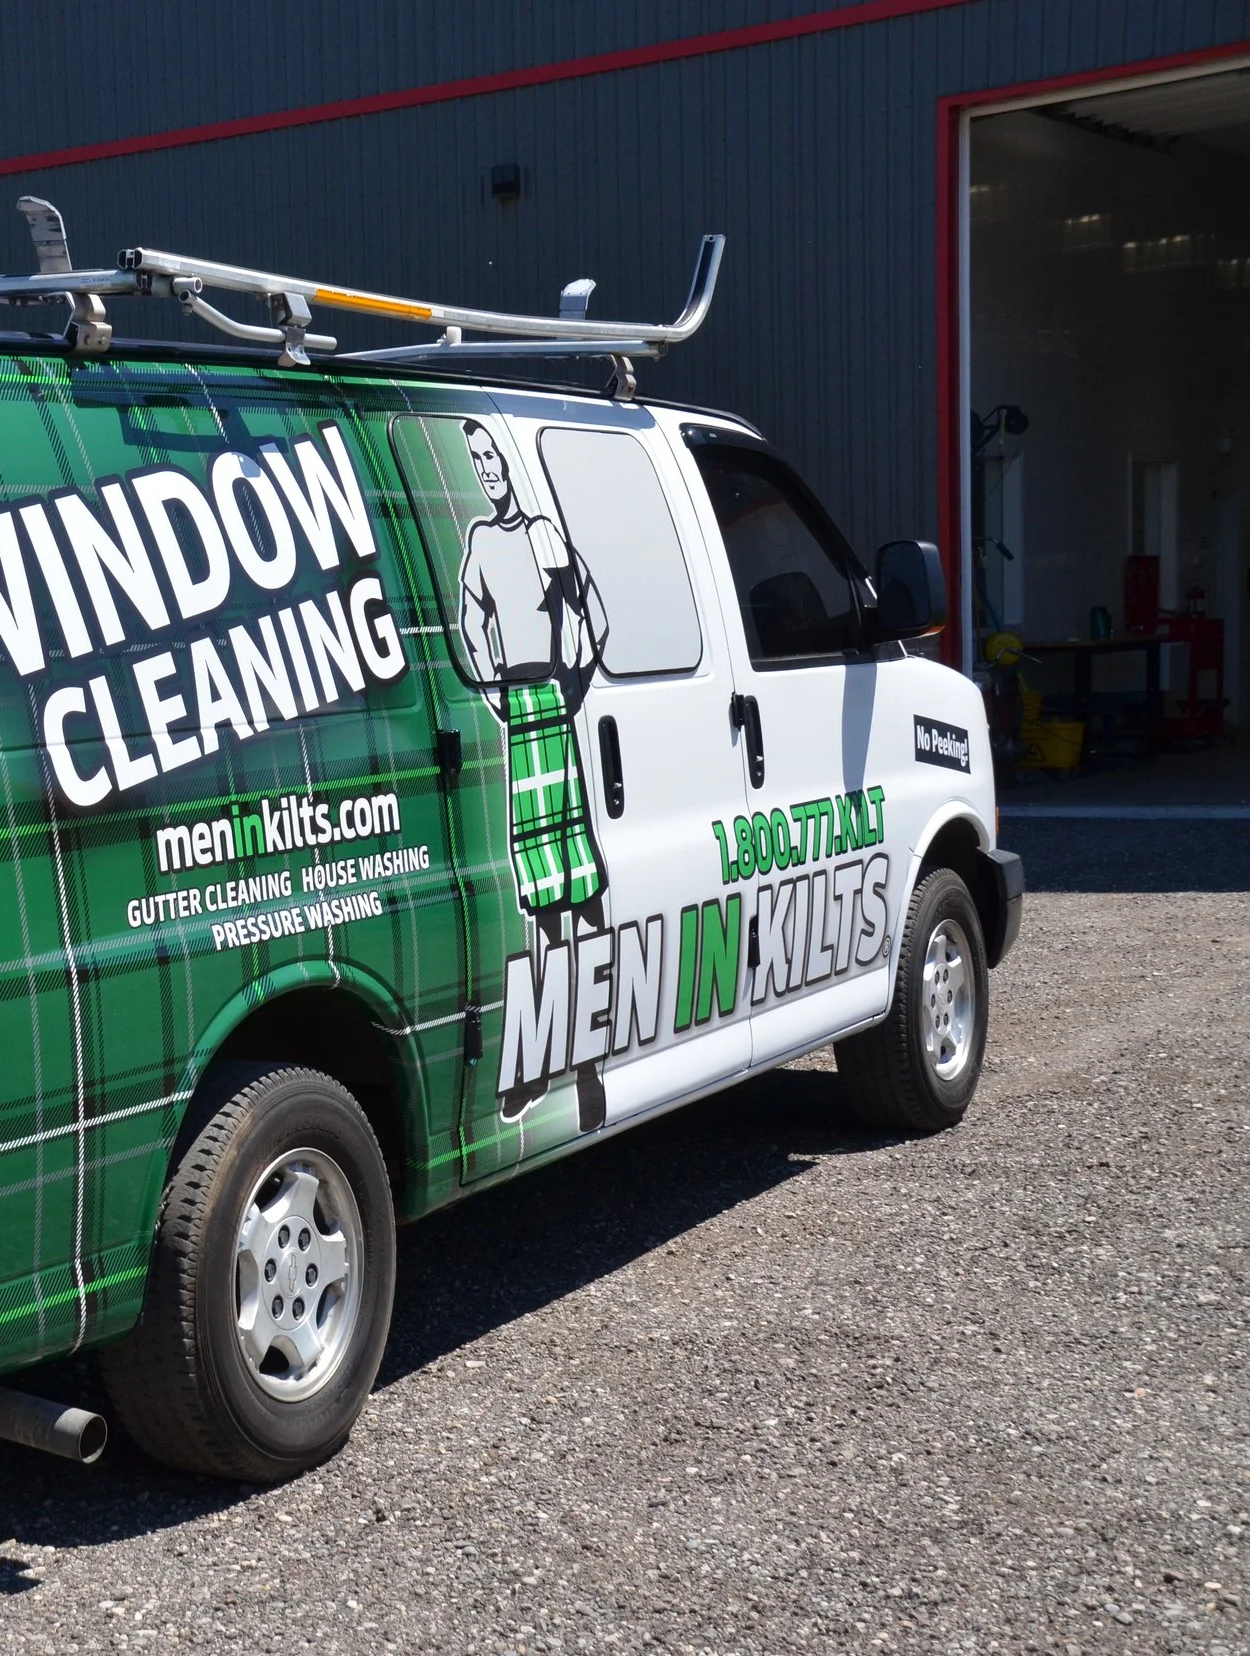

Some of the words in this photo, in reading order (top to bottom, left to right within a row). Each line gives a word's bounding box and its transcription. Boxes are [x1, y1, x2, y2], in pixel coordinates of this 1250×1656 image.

[42, 577, 408, 808] CLEANING
[916, 725, 930, 751] No
[931, 728, 969, 767] Peeking!
[156, 792, 400, 872] meninkilts.com
[711, 785, 886, 885] 1.800.777.KILT
[127, 888, 202, 929] GUTTER
[205, 870, 292, 913] CLEANING
[302, 862, 357, 893] HOUSE
[359, 845, 430, 882] WASHING
[211, 907, 305, 950] PRESSURE
[308, 891, 383, 930] WASHING
[495, 913, 665, 1099] MEN
[673, 893, 742, 1034] IN
